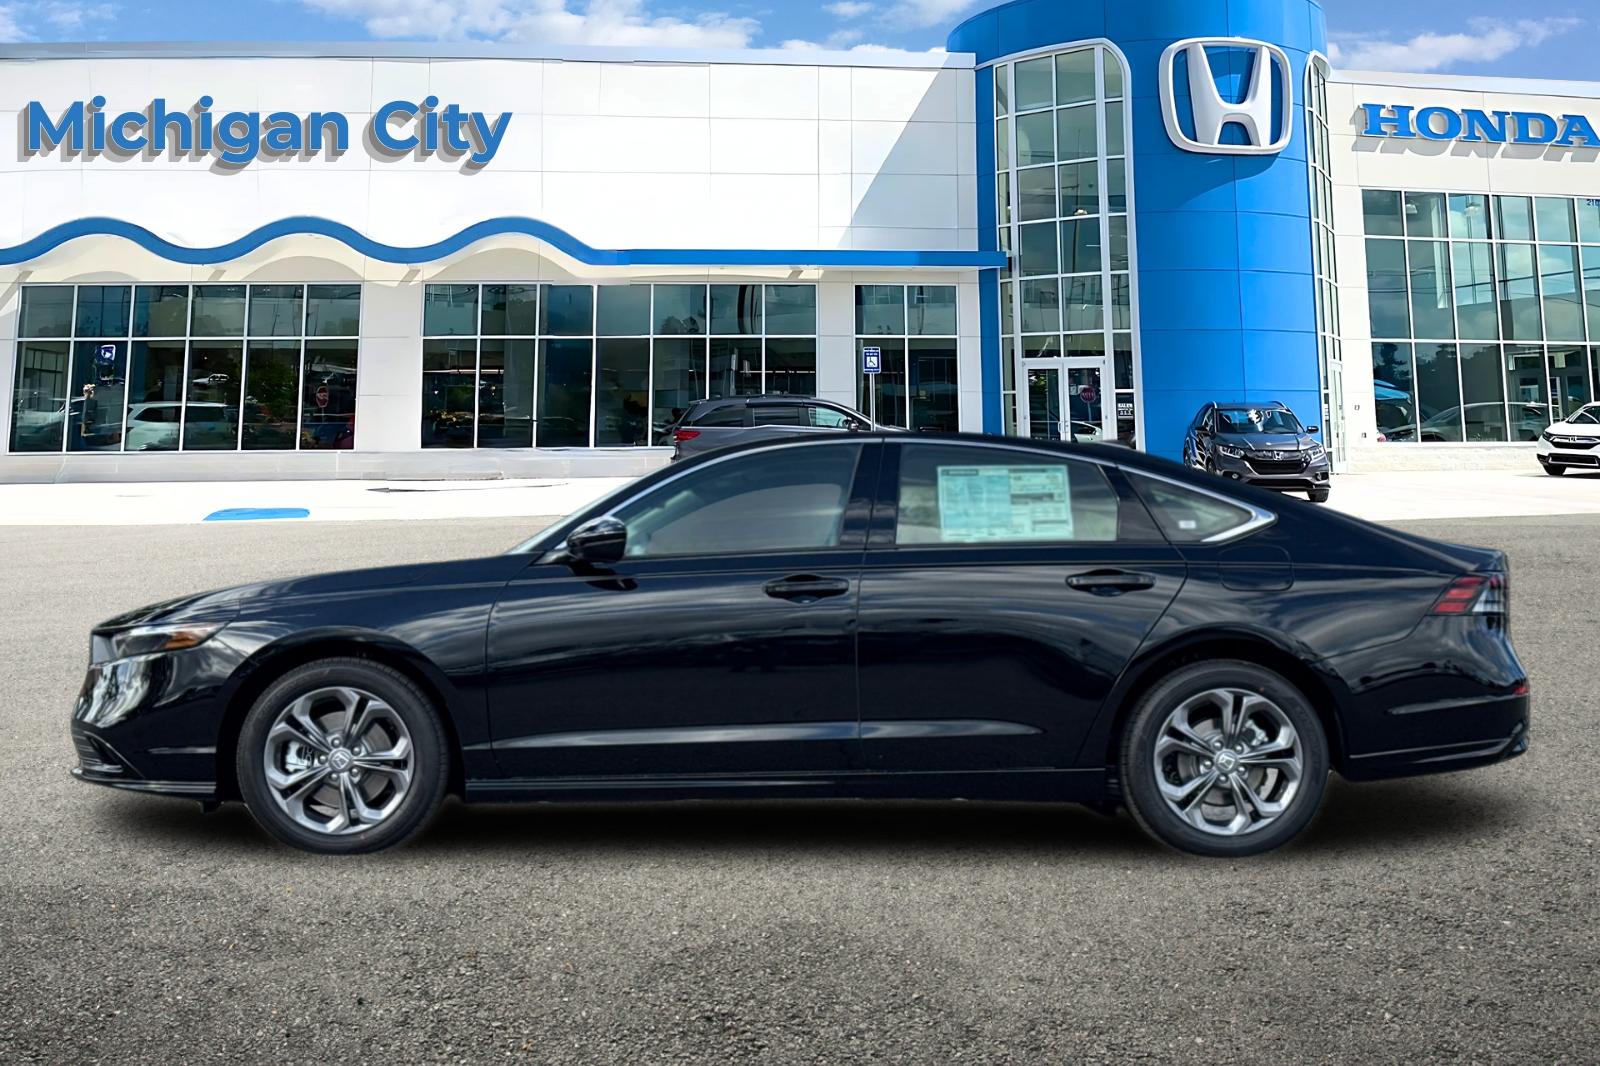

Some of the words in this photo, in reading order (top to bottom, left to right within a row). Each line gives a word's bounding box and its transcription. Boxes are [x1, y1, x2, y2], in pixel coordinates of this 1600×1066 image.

[28, 95, 349, 164] Michigan
[373, 95, 513, 164] City
[1361, 102, 1600, 148] HONDA
